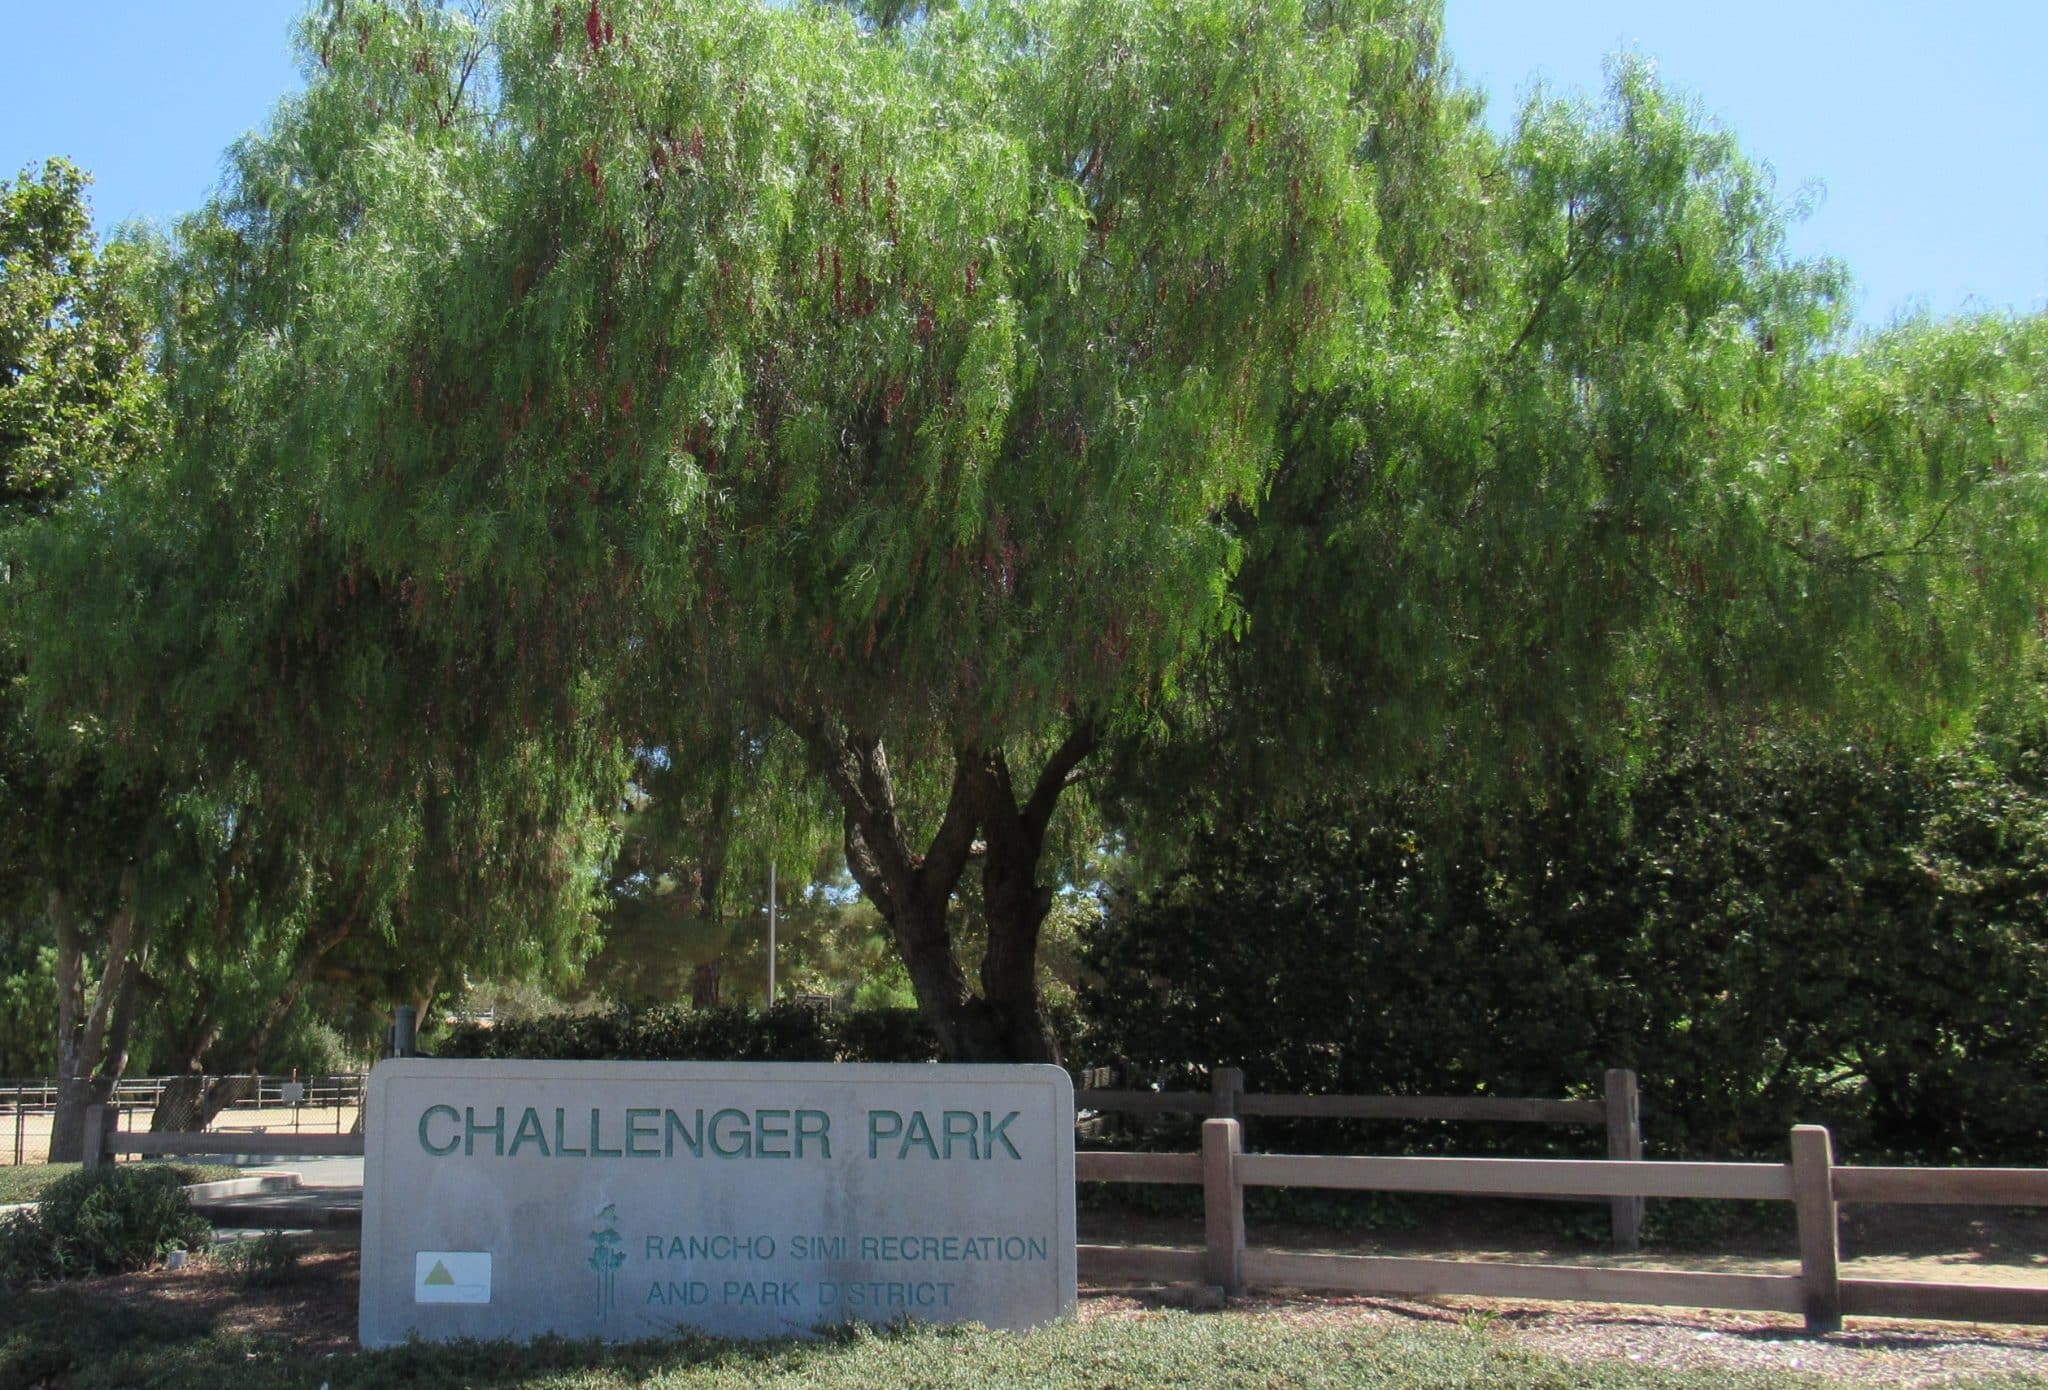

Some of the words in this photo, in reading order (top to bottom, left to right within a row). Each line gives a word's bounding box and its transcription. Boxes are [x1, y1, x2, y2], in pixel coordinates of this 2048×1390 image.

[418, 1104, 832, 1159] CHALLENGER
[868, 1109, 1022, 1160] PARK
[646, 1235, 776, 1260] RANCHO
[790, 1235, 847, 1260] SIMI
[860, 1235, 1048, 1261] RECREATION
[647, 1280, 709, 1304] AND
[723, 1281, 801, 1305] PARK
[818, 1281, 955, 1306] DSTRICT
